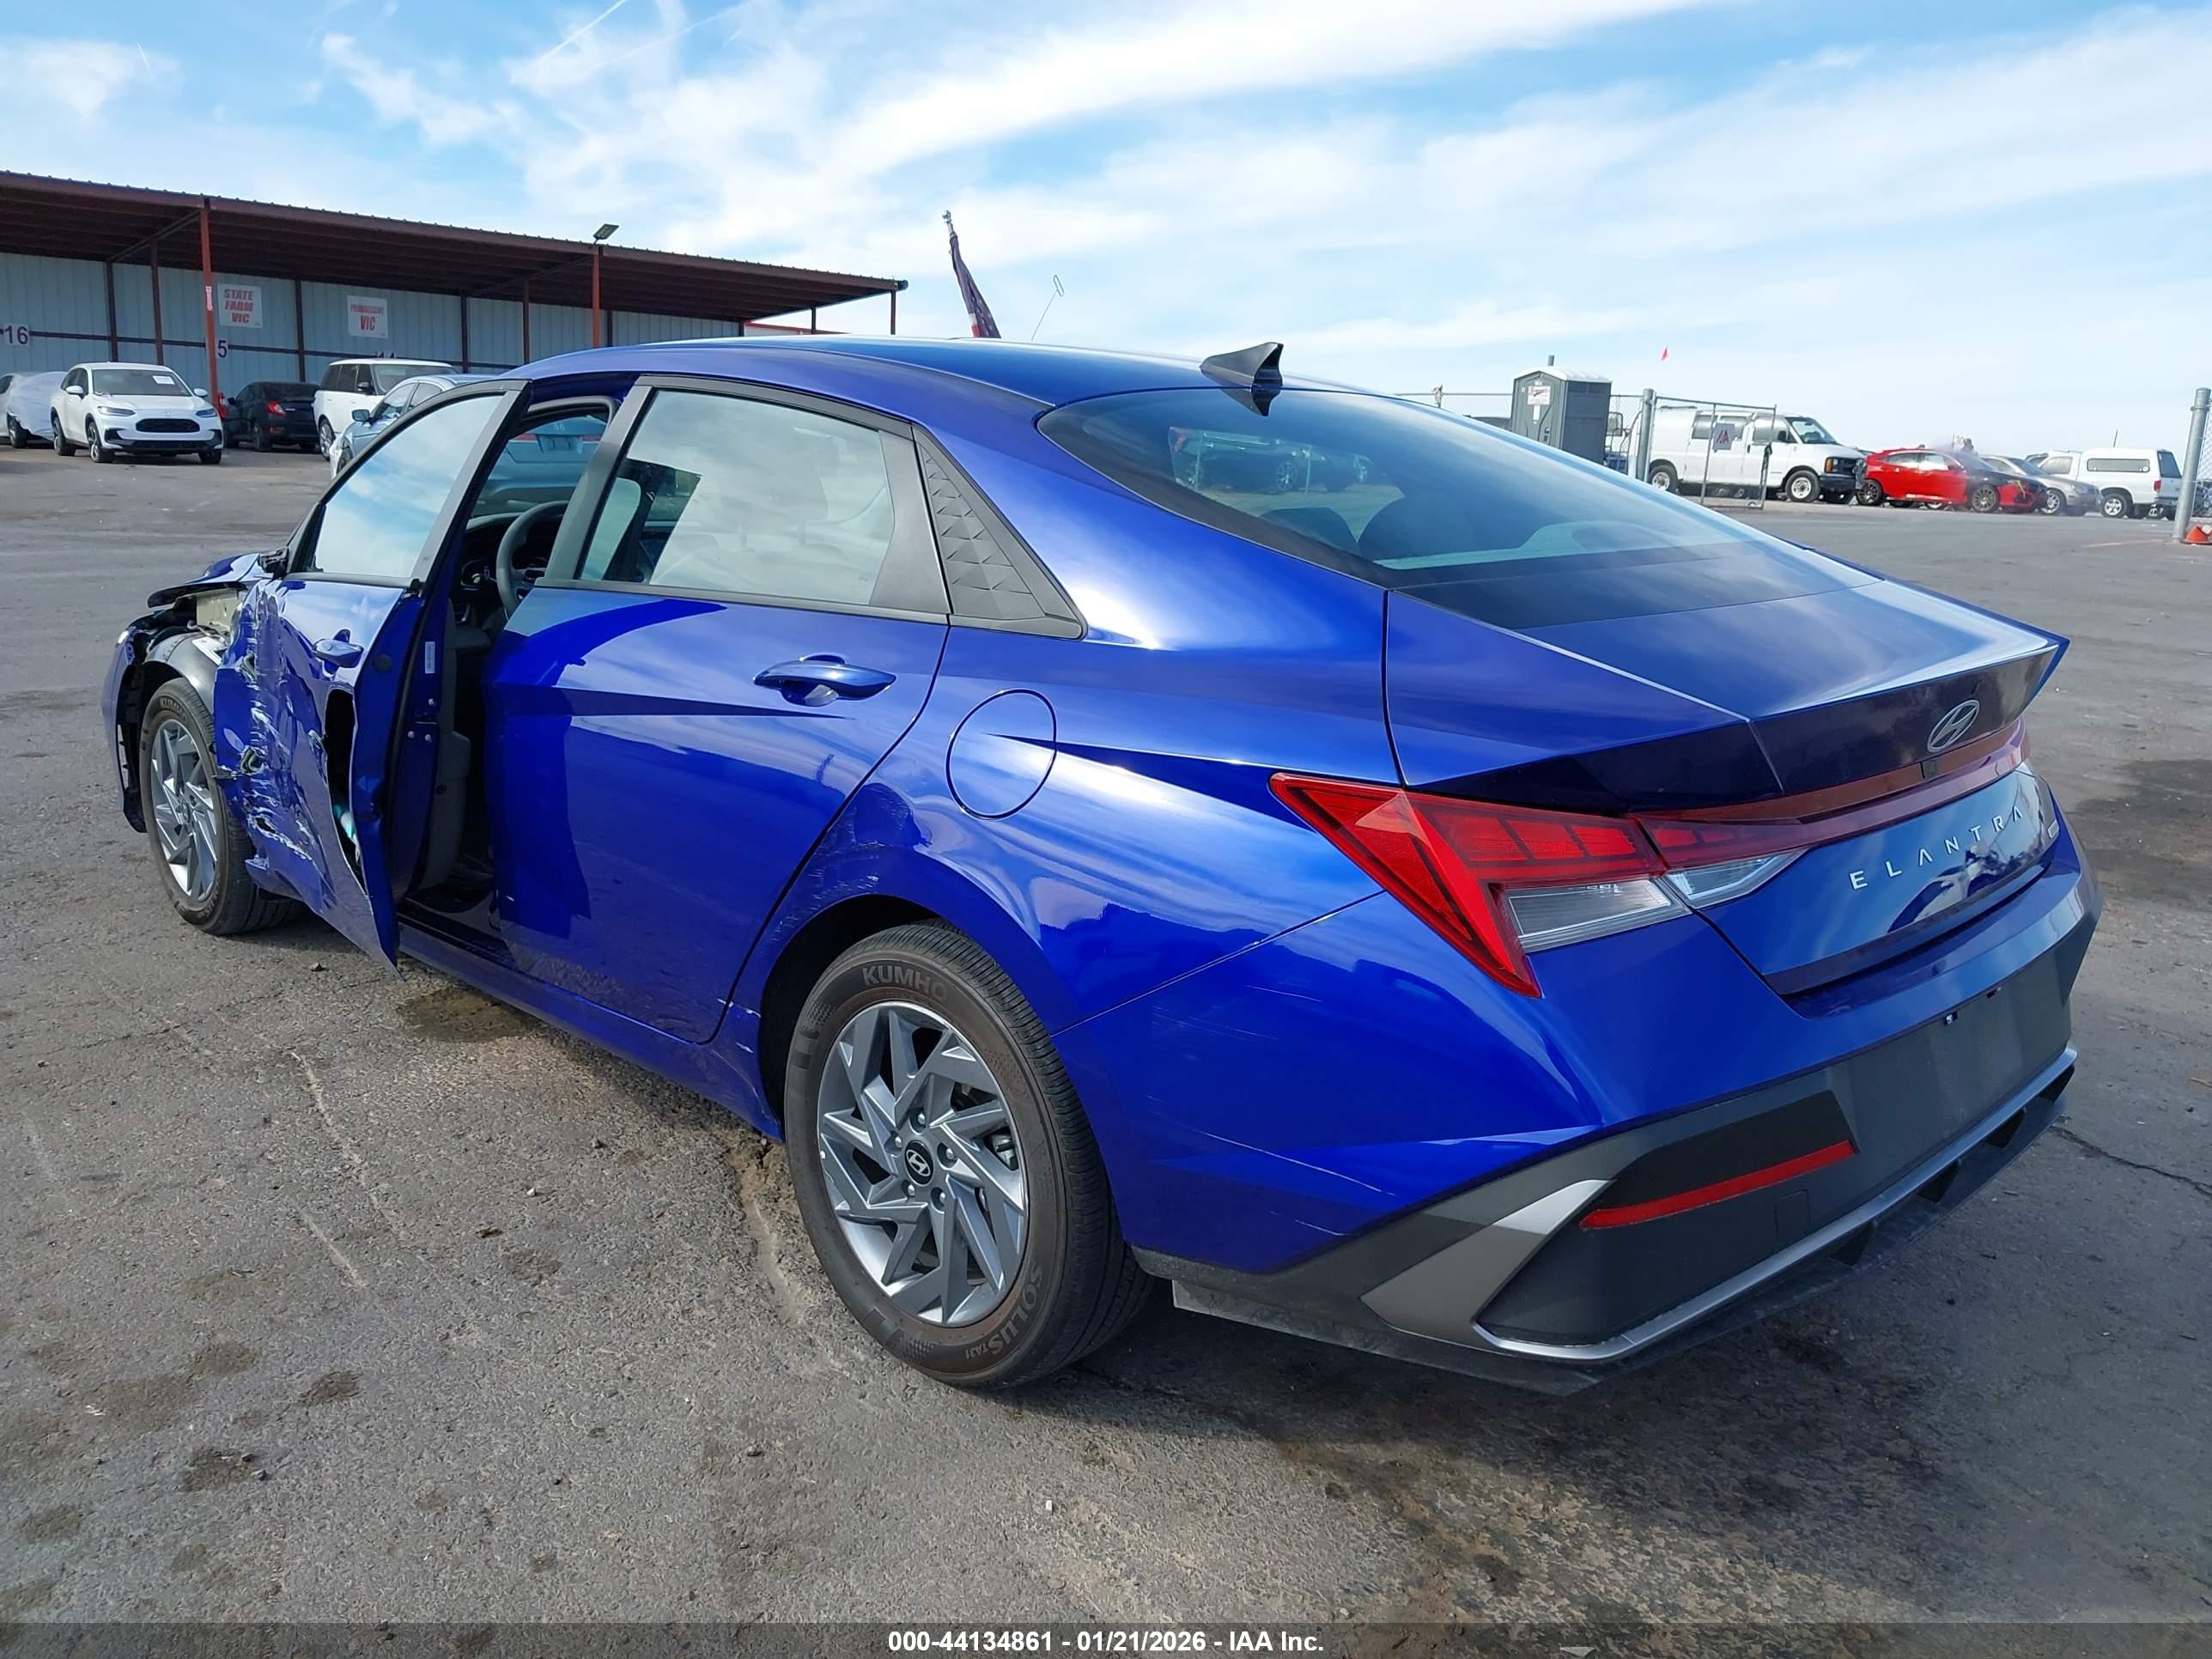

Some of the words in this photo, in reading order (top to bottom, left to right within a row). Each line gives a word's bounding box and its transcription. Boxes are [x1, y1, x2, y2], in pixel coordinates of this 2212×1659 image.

[224, 289, 254, 301] STATE
[225, 301, 253, 312] FARM
[232, 313, 249, 324] VIC
[361, 315, 376, 331] VIC
[4, 325, 28, 345] 16
[217, 339, 228, 358] 5
[1849, 805, 2024, 890] ELANTRA
[862, 965, 948, 1004] KUMHO
[988, 1262, 1043, 1355] SOLUS
